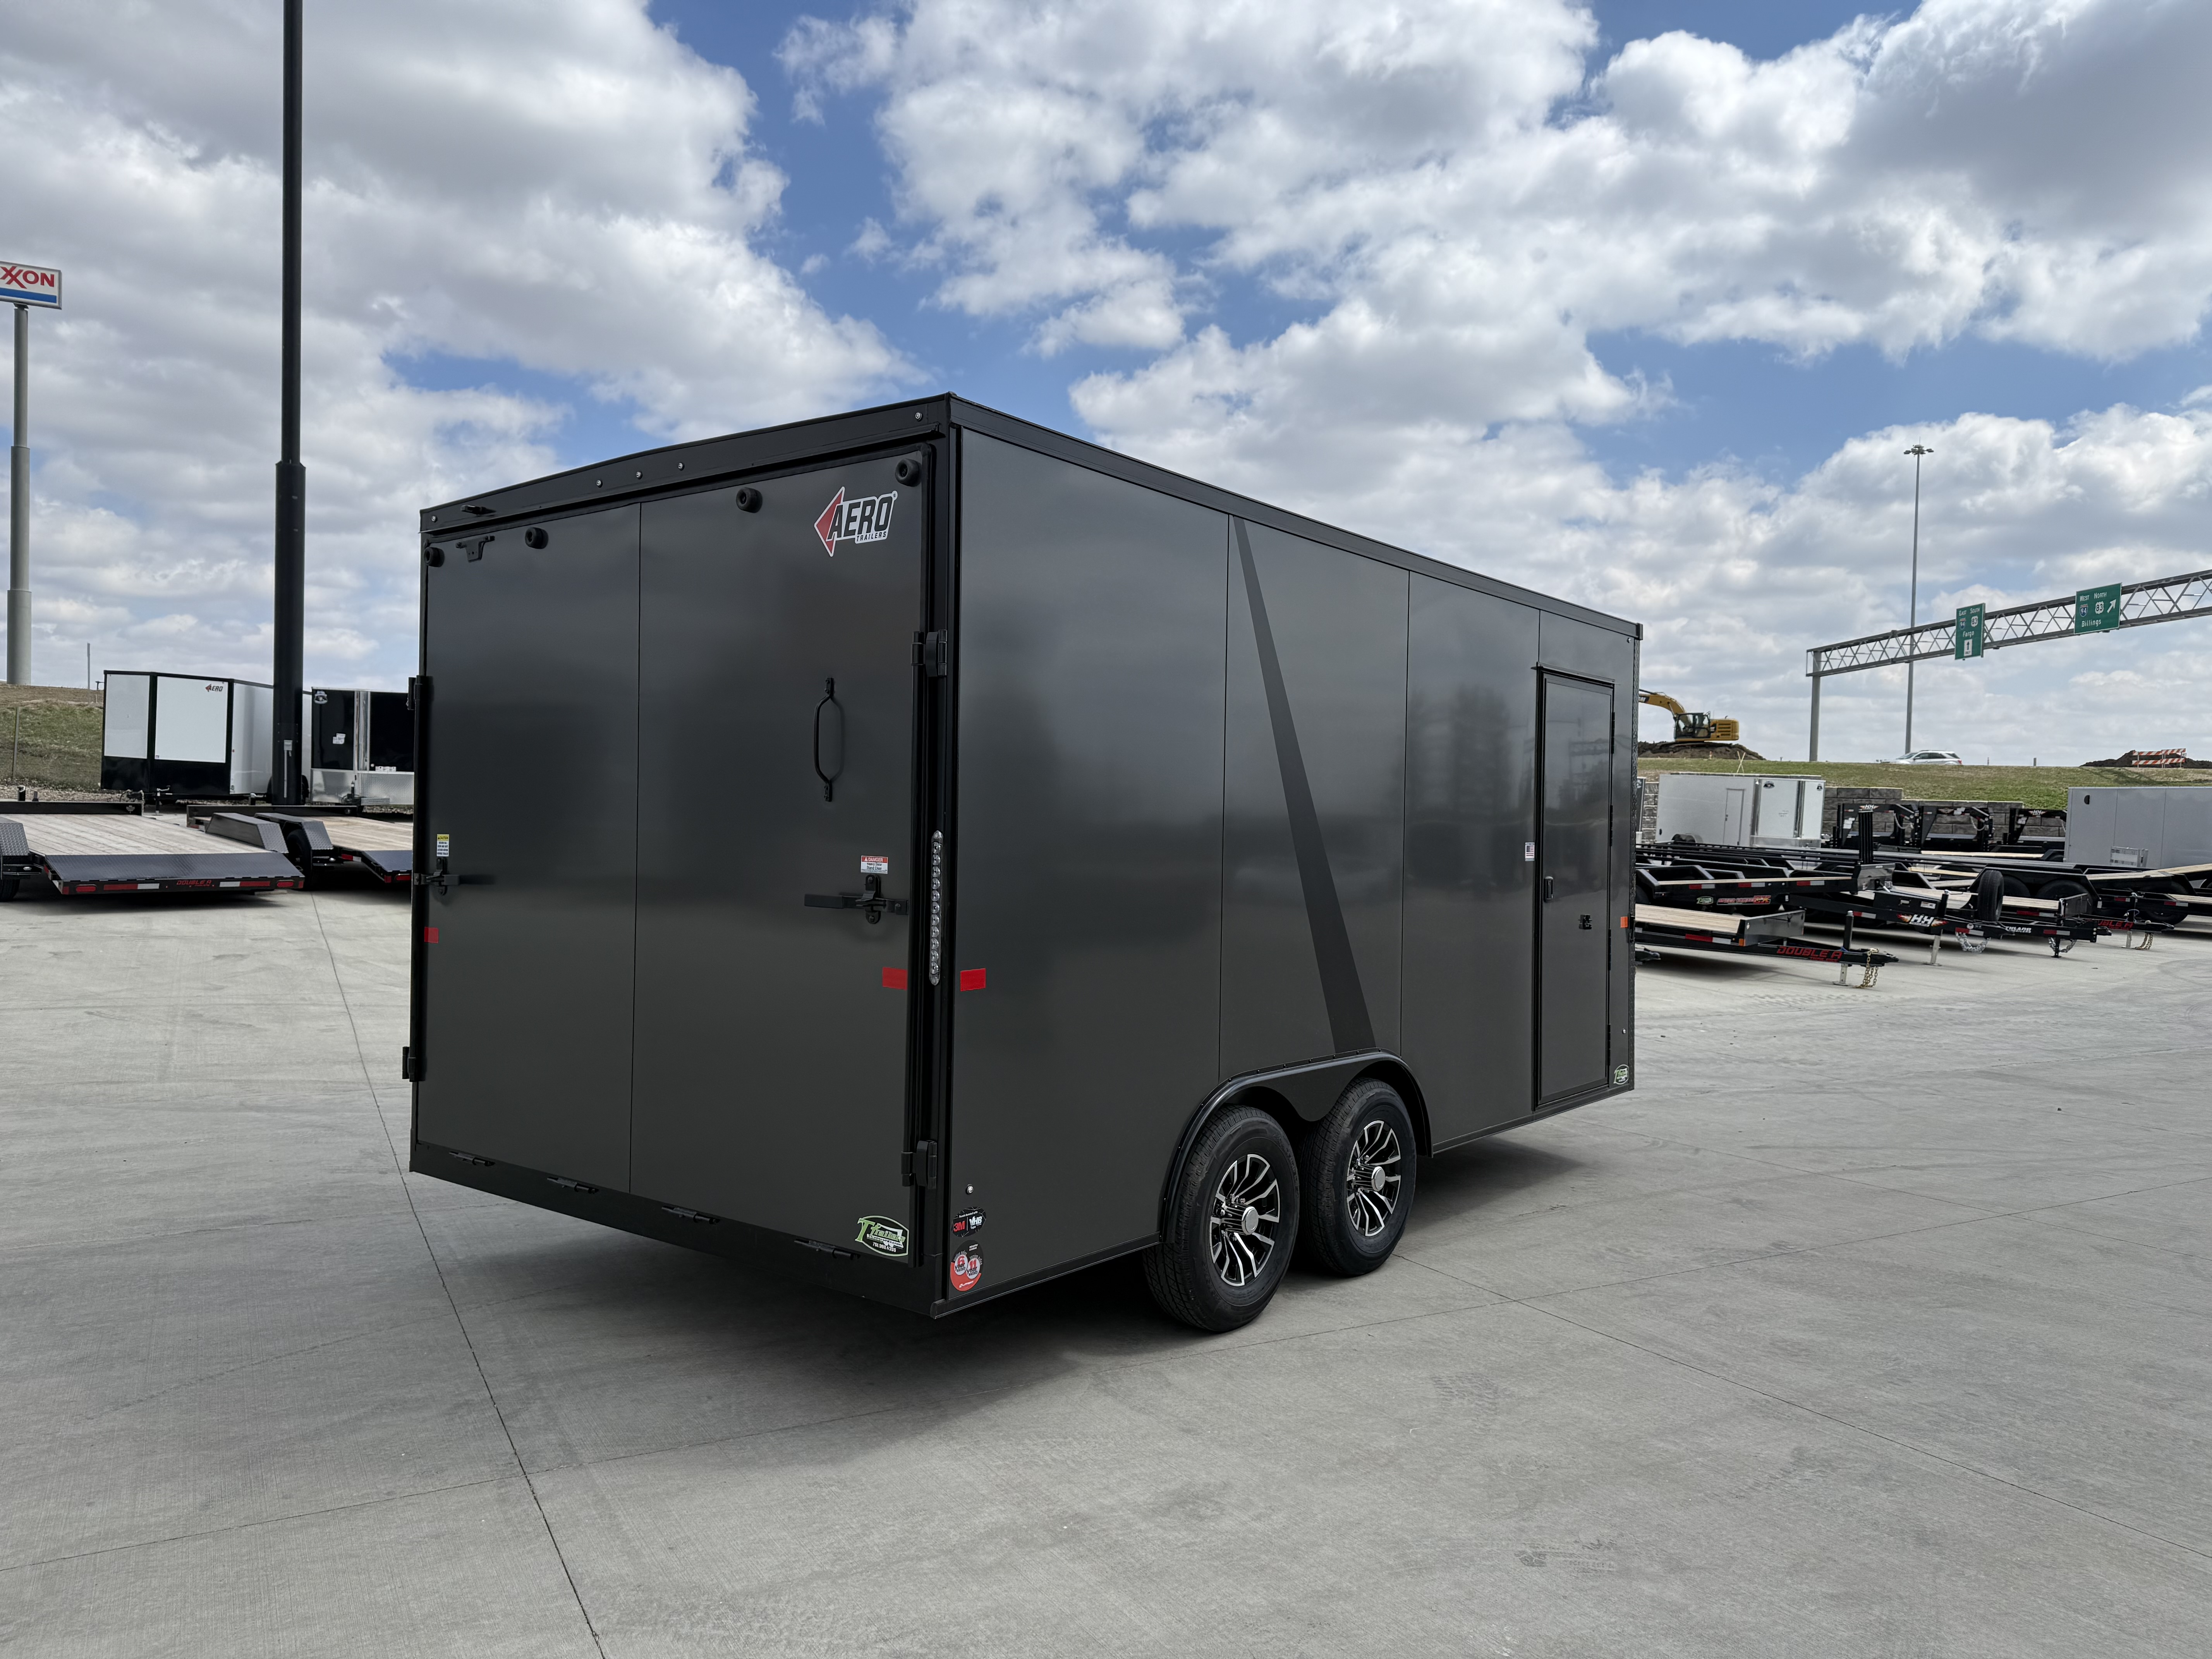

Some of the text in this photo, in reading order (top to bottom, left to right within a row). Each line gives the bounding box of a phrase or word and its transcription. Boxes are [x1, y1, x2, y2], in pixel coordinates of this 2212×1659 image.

[0, 266, 55, 289] XXON
[827, 496, 893, 539] AERO
[857, 531, 886, 542] TRAILERS
[1777, 946, 1830, 958] DOUBLE
[1831, 951, 1843, 960] A
[954, 1221, 965, 1232] 3M
[969, 1216, 982, 1226] VHB
